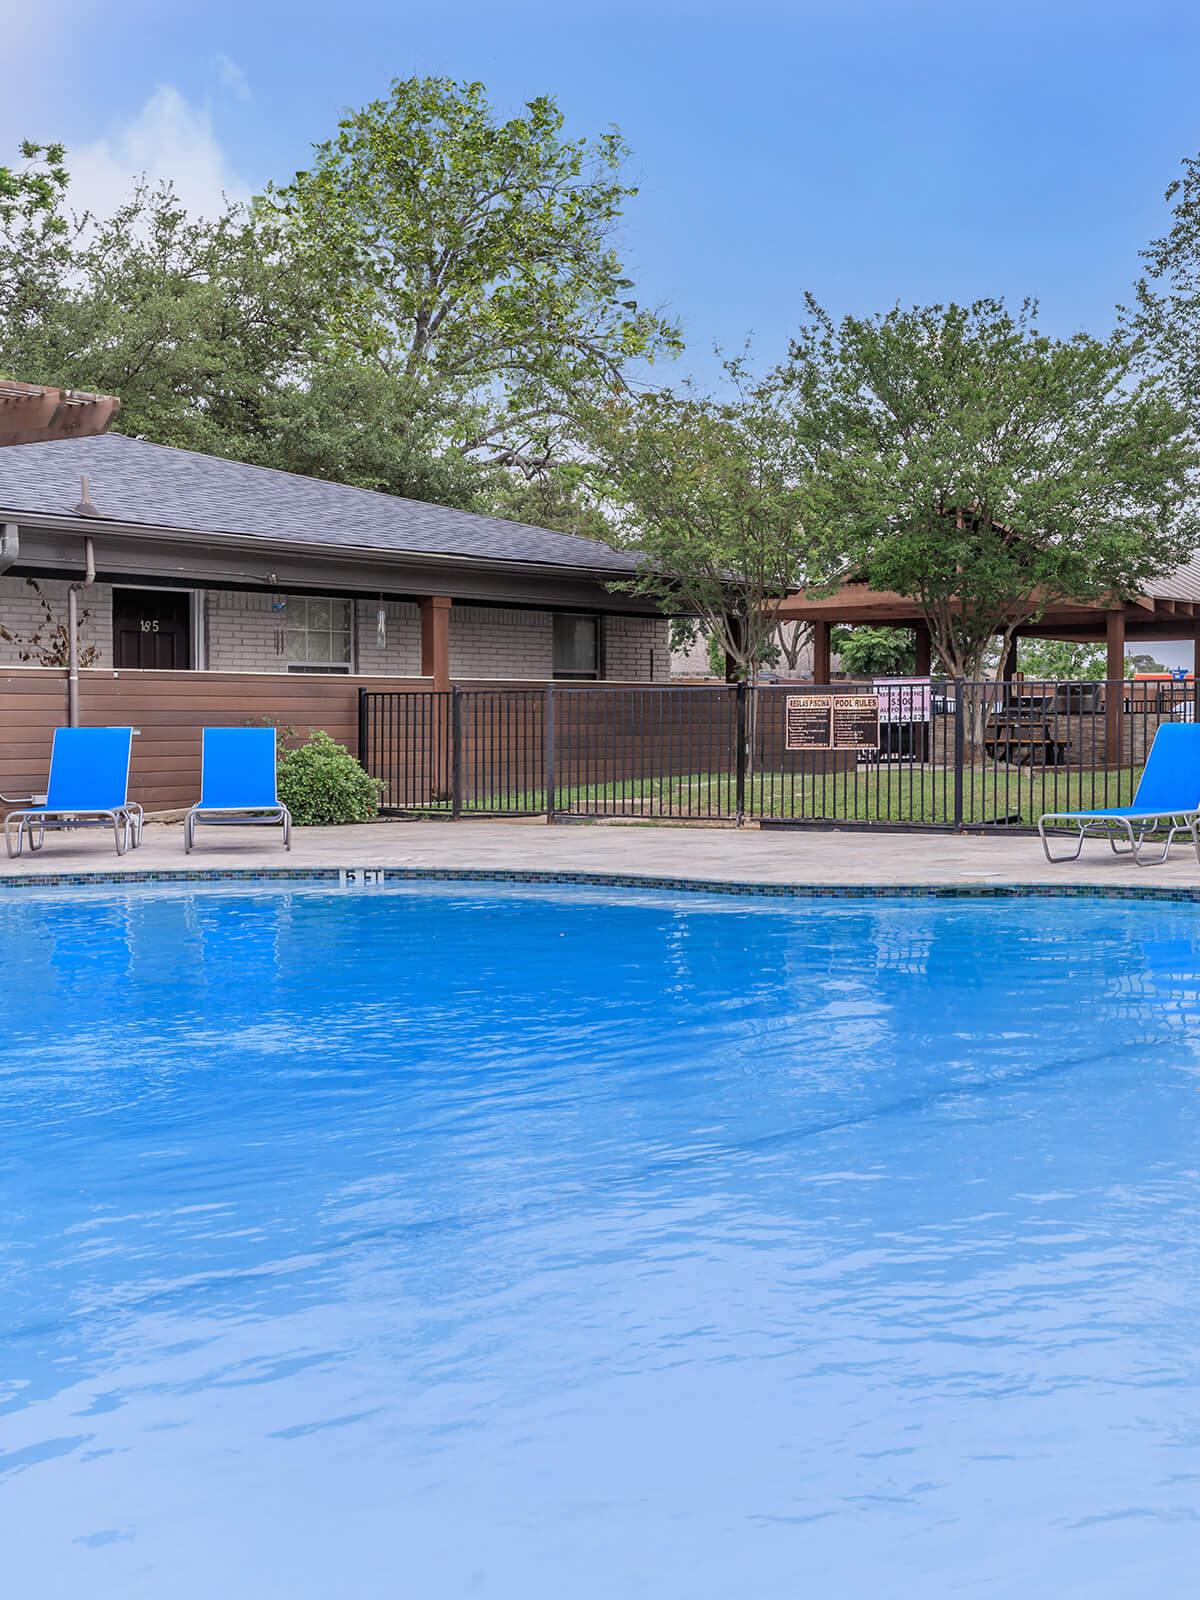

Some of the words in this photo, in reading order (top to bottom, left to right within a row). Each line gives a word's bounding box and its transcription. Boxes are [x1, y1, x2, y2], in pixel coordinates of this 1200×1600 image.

[140, 619, 160, 632] 185
[835, 699, 853, 707] POOL
[855, 698, 877, 707] RULES
[346, 869, 356, 884] 5
[364, 869, 382, 886] FT
